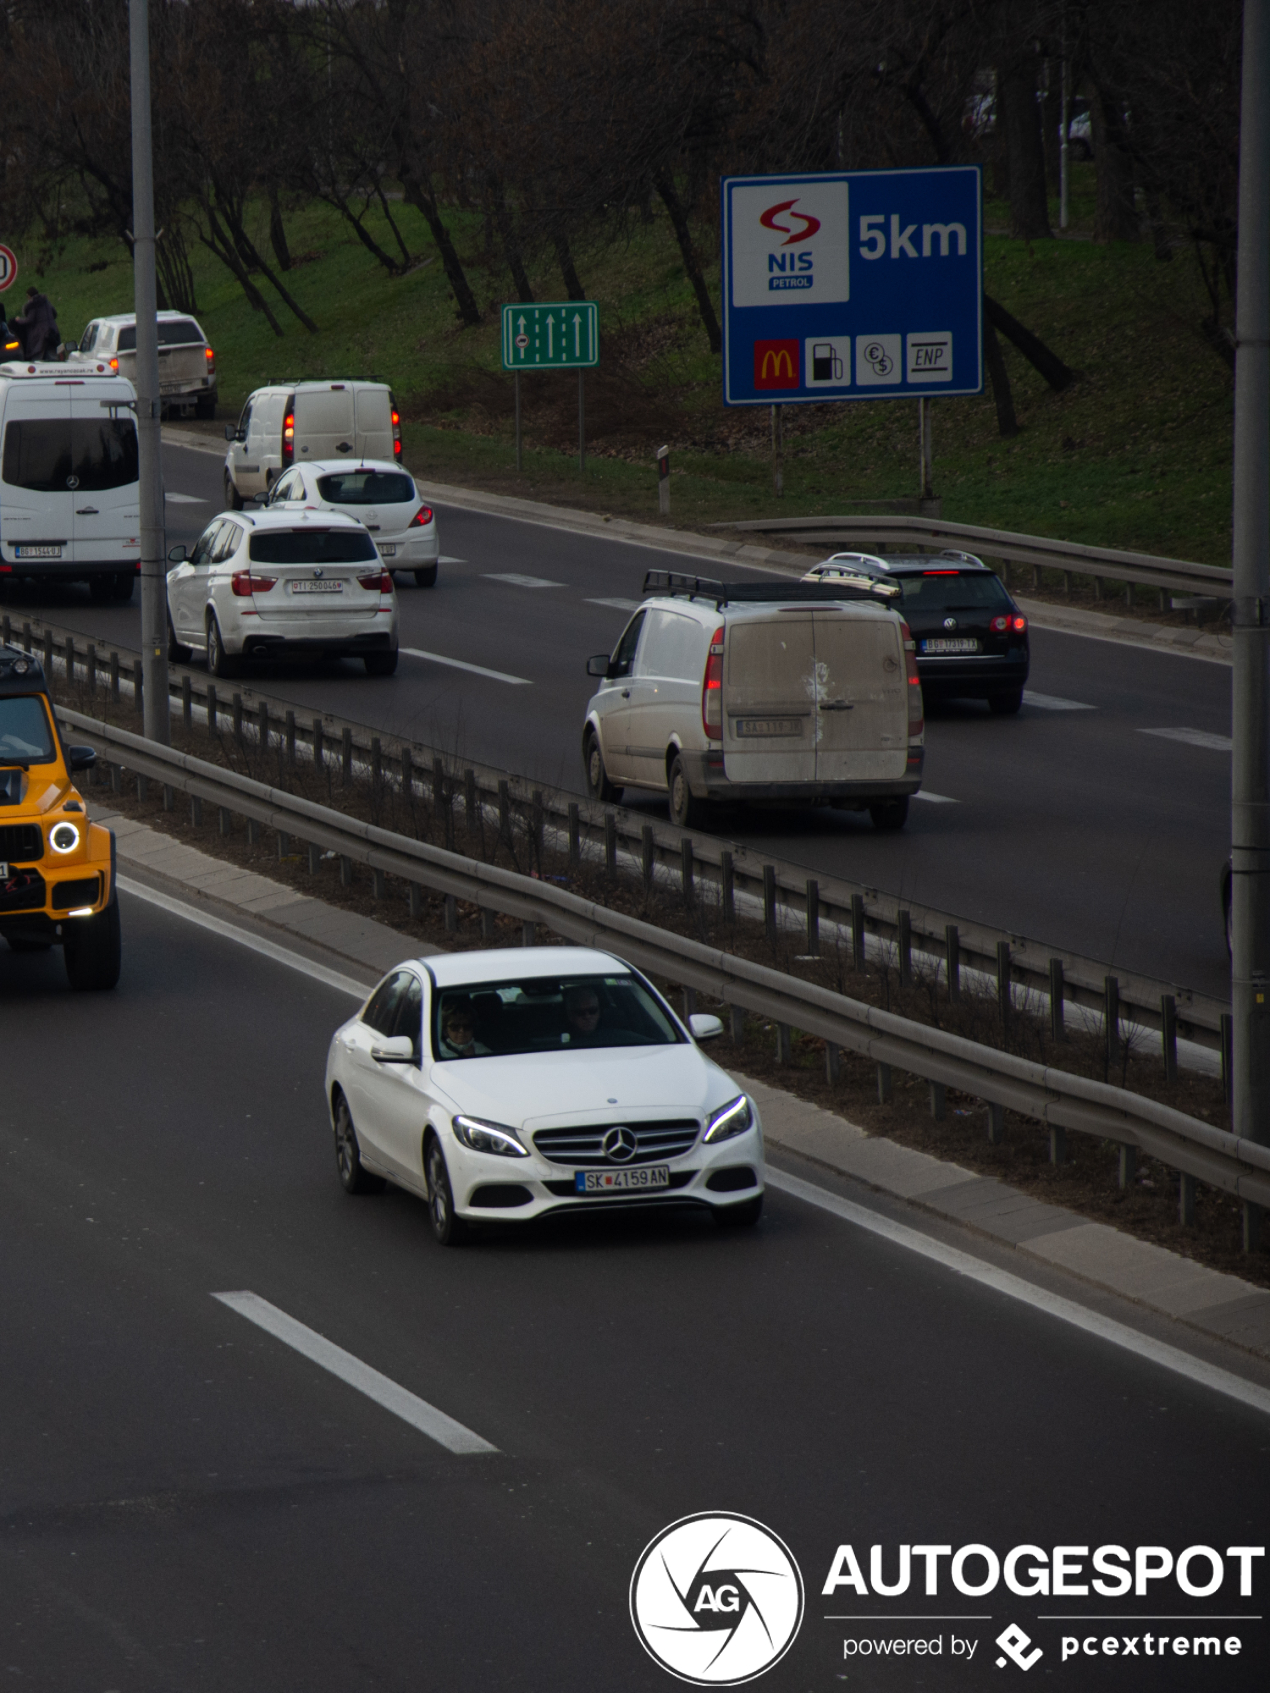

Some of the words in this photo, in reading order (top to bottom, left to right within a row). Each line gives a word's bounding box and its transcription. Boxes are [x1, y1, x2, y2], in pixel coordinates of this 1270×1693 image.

[859, 213, 967, 260] 5km
[768, 252, 813, 272] NIS
[772, 277, 810, 288] PETROL
[915, 347, 944, 367] ENP
[20, 547, 29, 555] BG
[928, 639, 940, 649] BG
[745, 721, 758, 733] SA
[587, 1173, 604, 1189] SK
